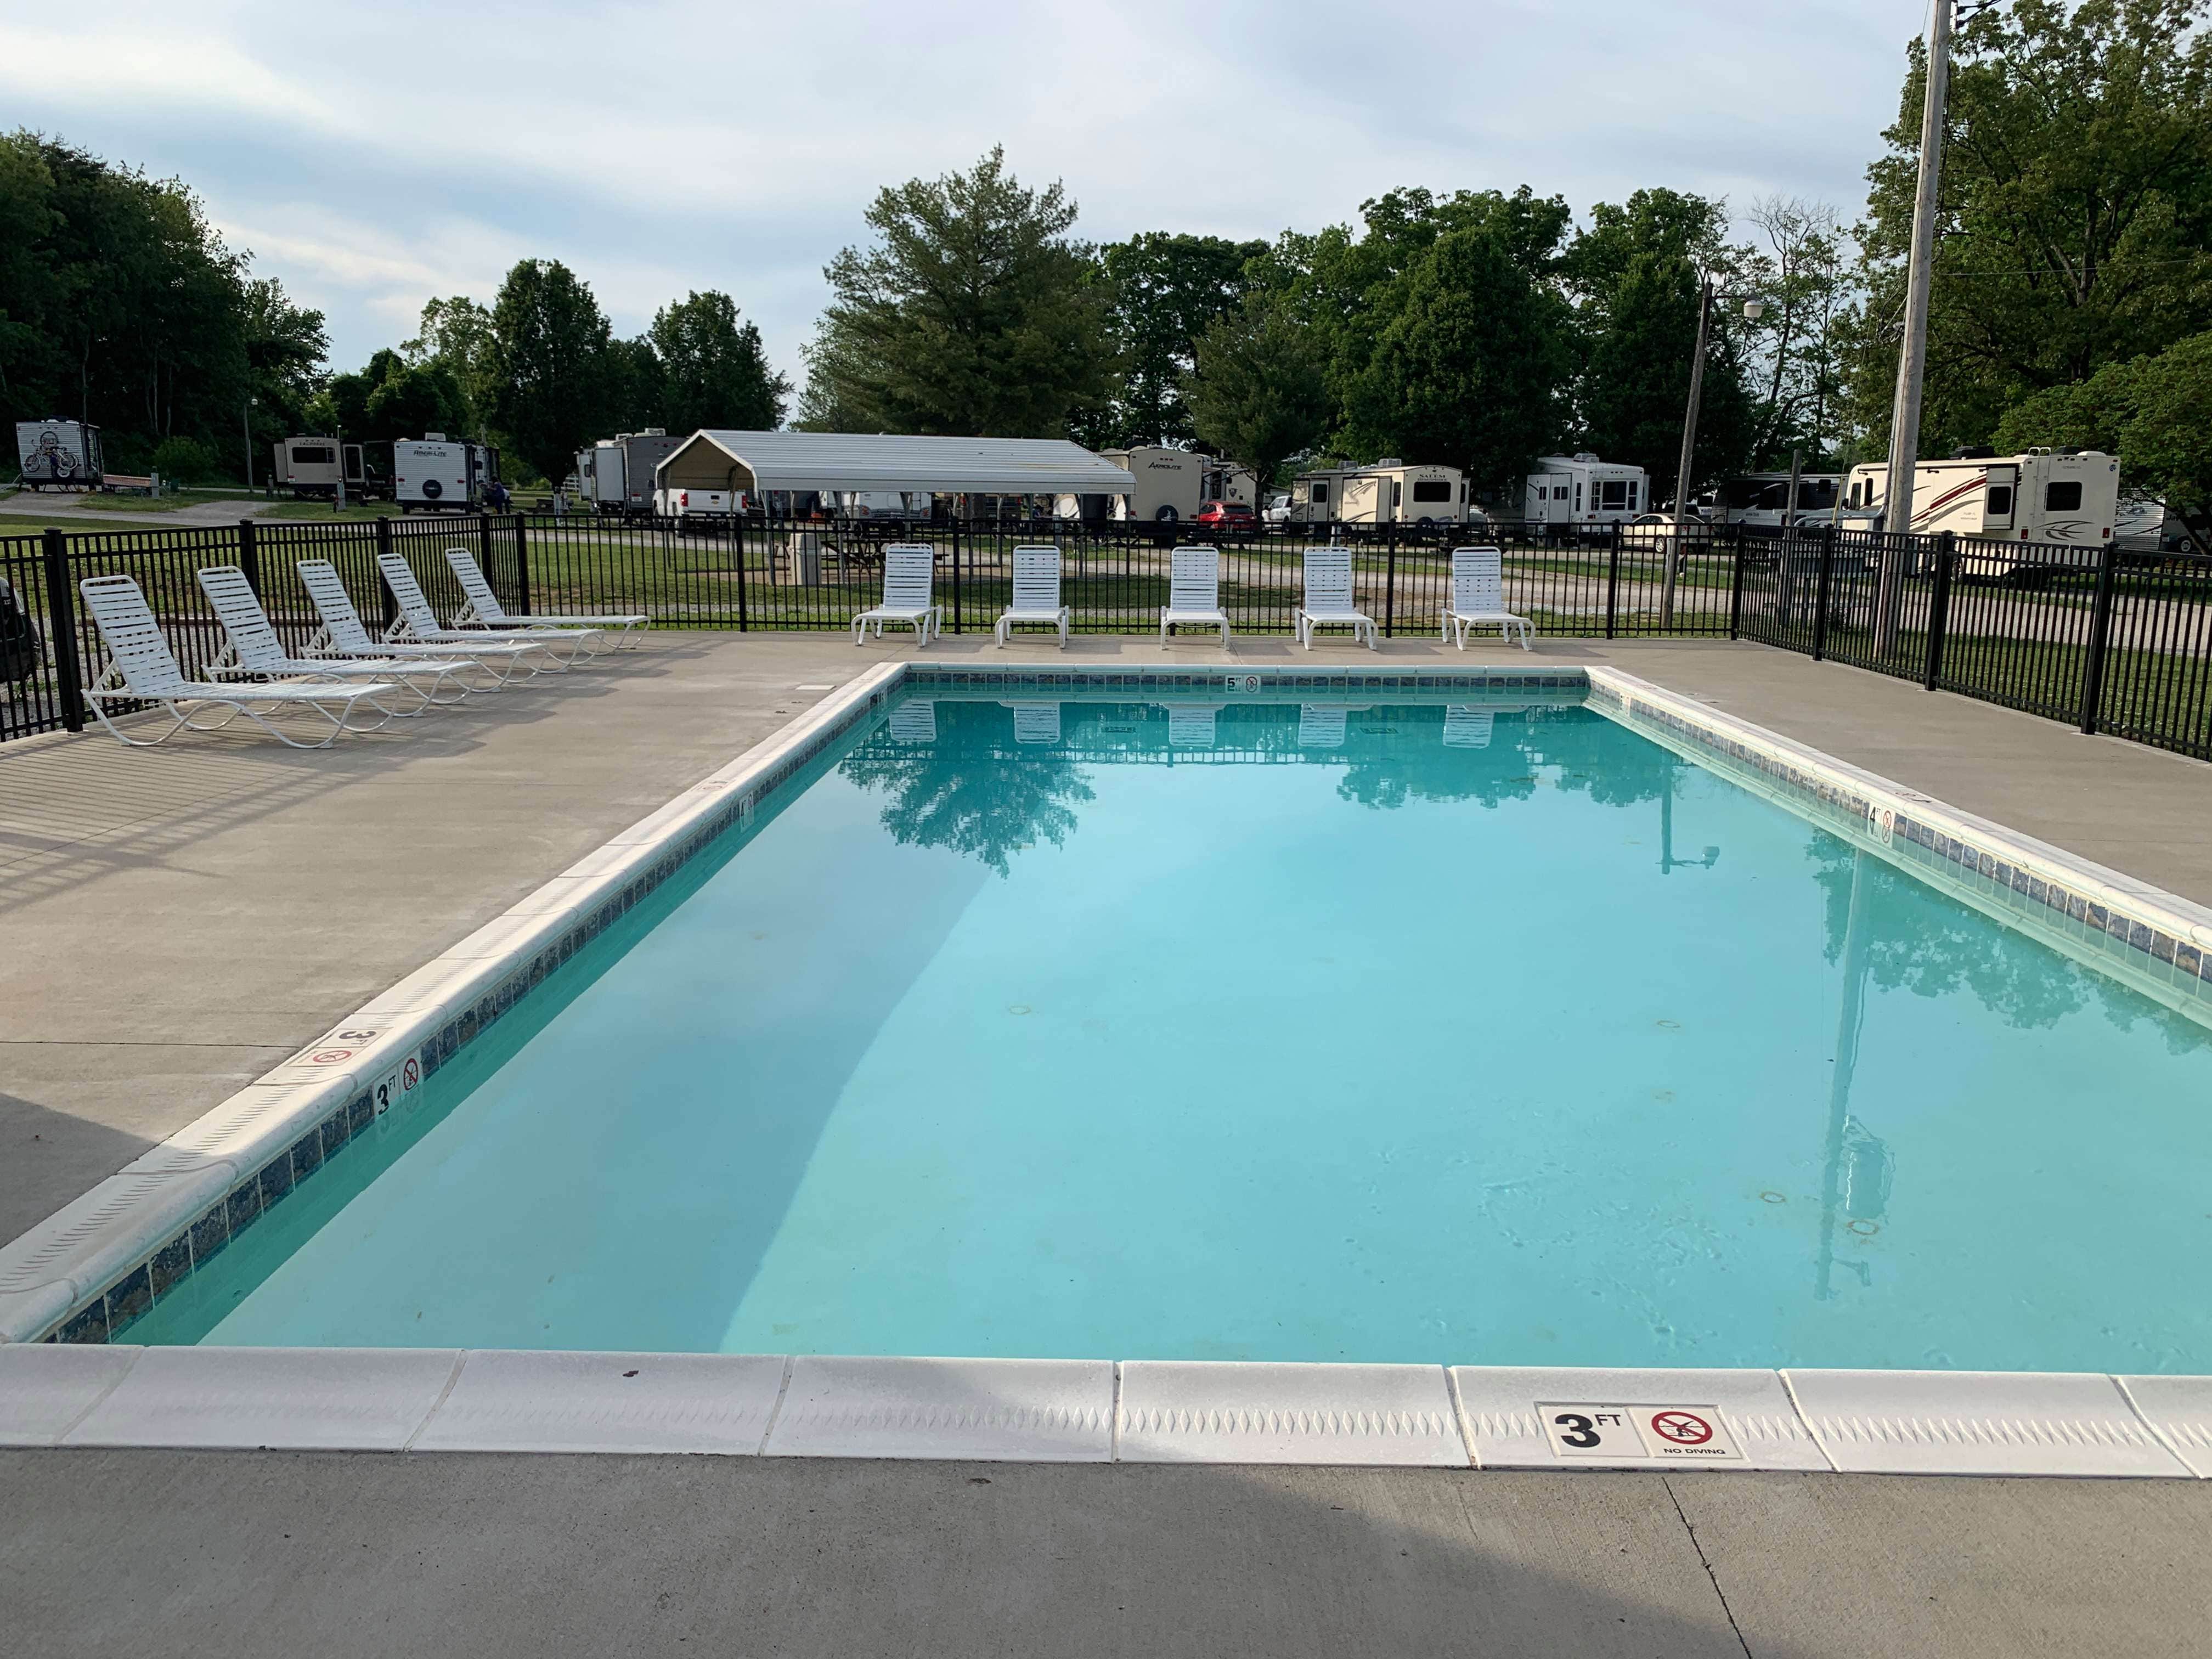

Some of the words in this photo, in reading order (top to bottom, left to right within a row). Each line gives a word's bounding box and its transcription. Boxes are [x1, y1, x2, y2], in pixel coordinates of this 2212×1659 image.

[1870, 806, 1876, 822] 4
[338, 1031, 377, 1040] 3
[377, 1084, 390, 1115] 3
[388, 1075, 396, 1091] FT
[1555, 1414, 1601, 1448] 3
[1594, 1414, 1621, 1426] FT
